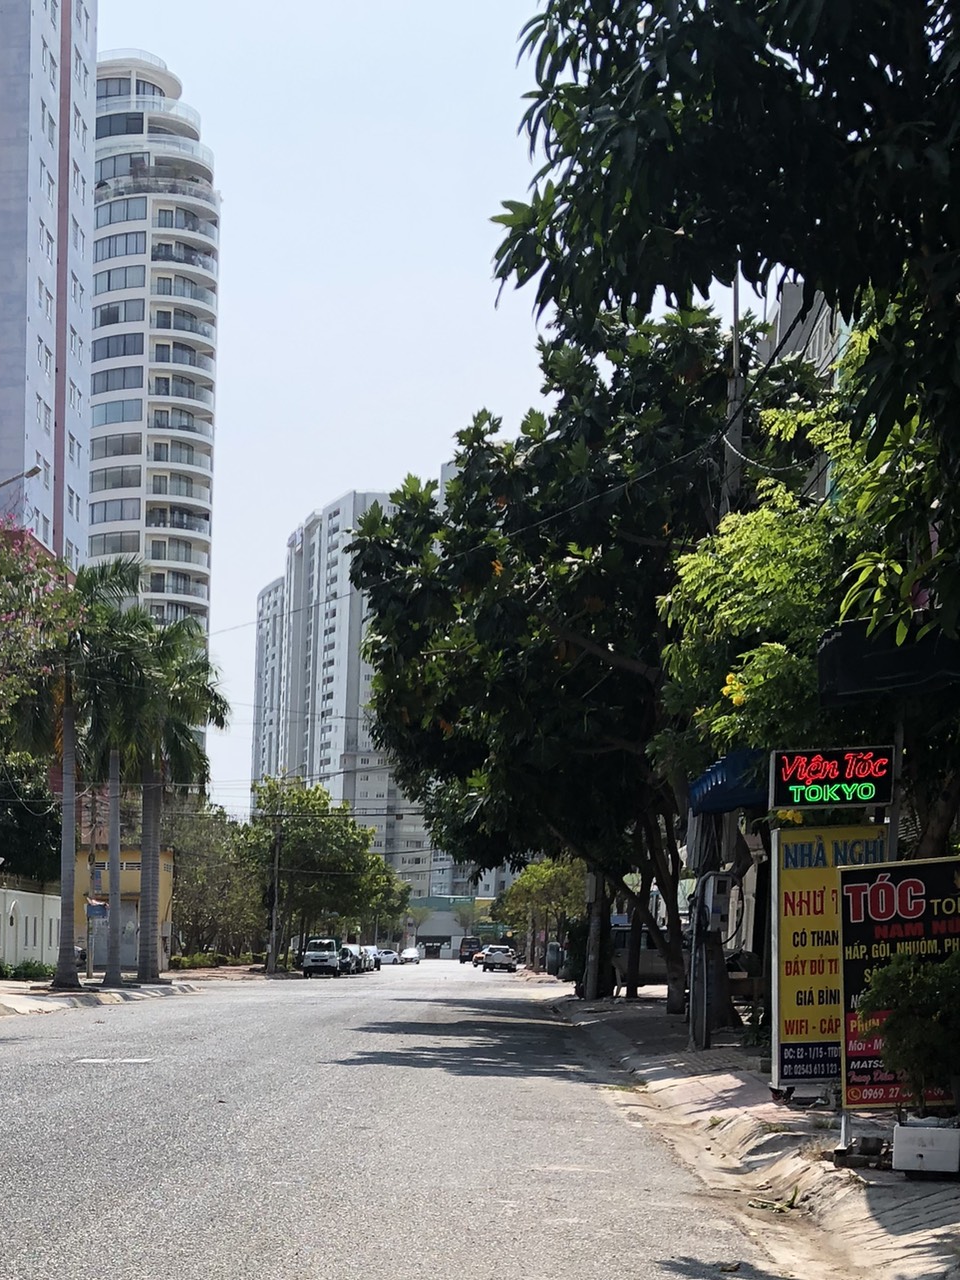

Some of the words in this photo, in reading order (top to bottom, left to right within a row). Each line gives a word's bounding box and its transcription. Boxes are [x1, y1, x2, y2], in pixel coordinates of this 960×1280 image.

[781, 754, 839, 785] Viện
[844, 752, 889, 779] Tóc
[789, 783, 876, 802] TOKYO
[782, 835, 828, 870] NHÀ
[832, 830, 885, 868] NGHỈ
[784, 886, 827, 917] NHƯ
[843, 873, 926, 923] TÓC
[793, 928, 807, 948] CÓ
[874, 922, 925, 940] NAM
[845, 940, 869, 961] HẤP,
[796, 986, 815, 1007] GIÁ
[784, 1019, 809, 1036] WIFI
[820, 1015, 841, 1035] CÁP
[826, 1063, 838, 1075] 123
